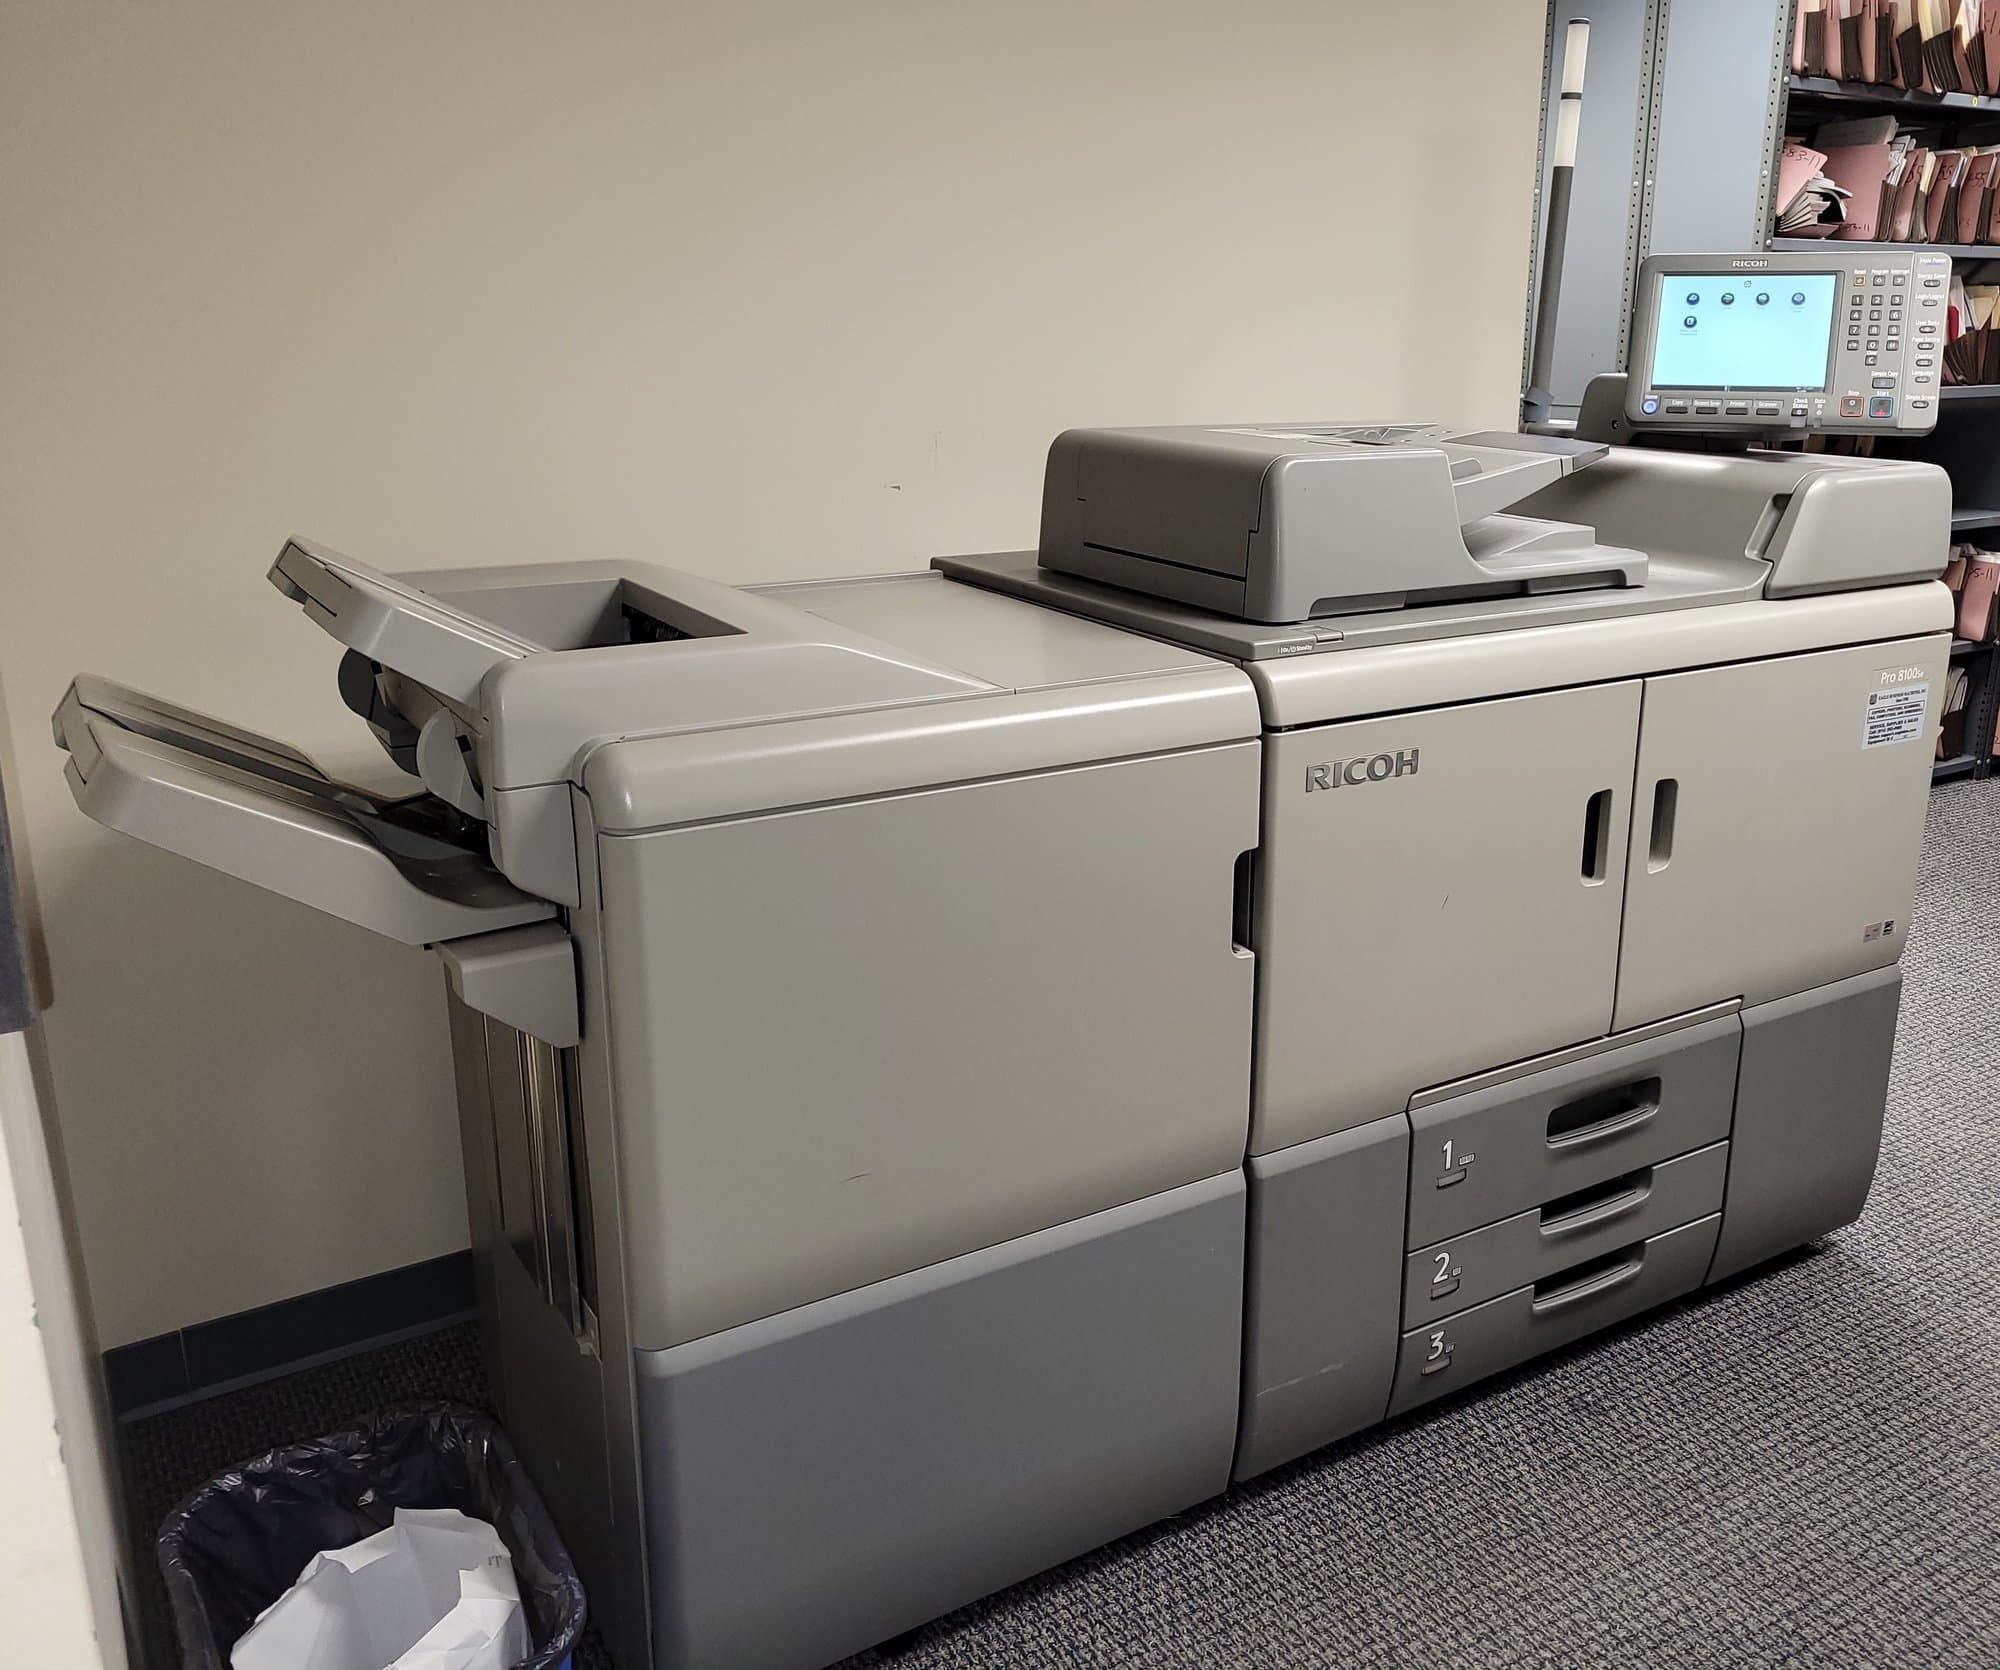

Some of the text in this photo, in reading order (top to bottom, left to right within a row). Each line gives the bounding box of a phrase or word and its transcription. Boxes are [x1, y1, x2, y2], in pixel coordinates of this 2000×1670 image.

[1732, 259, 1768, 268] RICOH
[1671, 399, 1684, 407] Copy
[1881, 671, 1896, 685] Pro
[1305, 748, 1420, 793] RICOH
[1442, 1138, 1454, 1171] 1
[1432, 1251, 1451, 1285] 2
[1427, 1330, 1445, 1361] 3
